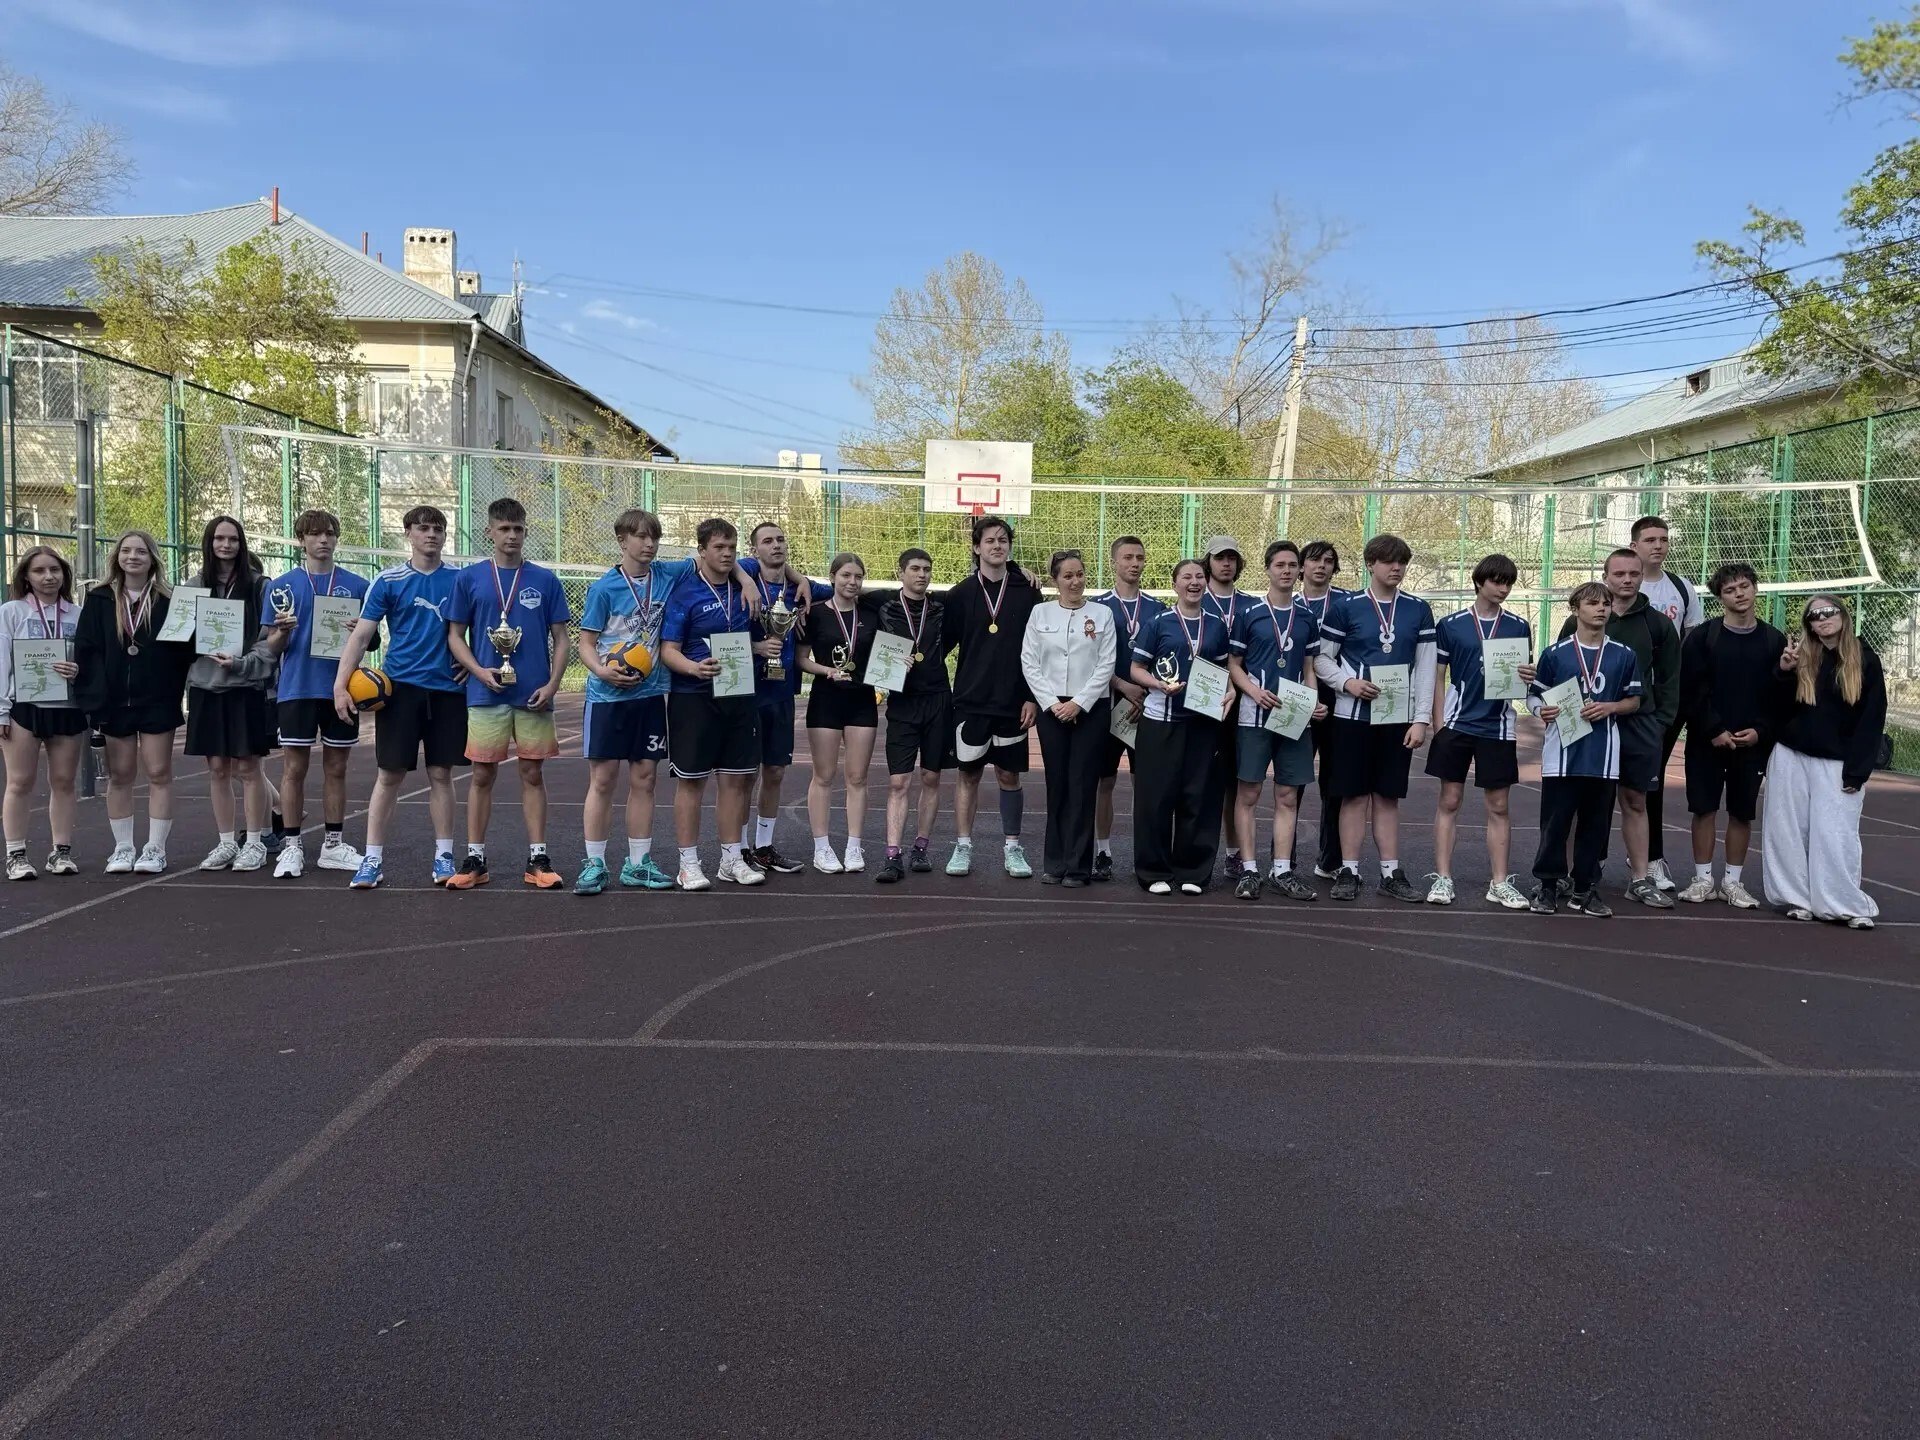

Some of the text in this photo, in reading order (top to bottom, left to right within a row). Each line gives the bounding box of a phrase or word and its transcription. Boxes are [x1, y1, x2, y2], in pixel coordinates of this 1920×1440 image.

[1379, 622, 1395, 644] 8
[881, 643, 904, 654] ГРАМОТА
[1197, 672, 1221, 685] ГРАМОТА
[1580, 671, 1606, 694] 10
[1286, 689, 1310, 701] ГРАМОТА
[1556, 692, 1576, 706] ГРАМОТА
[646, 734, 667, 752] 34
